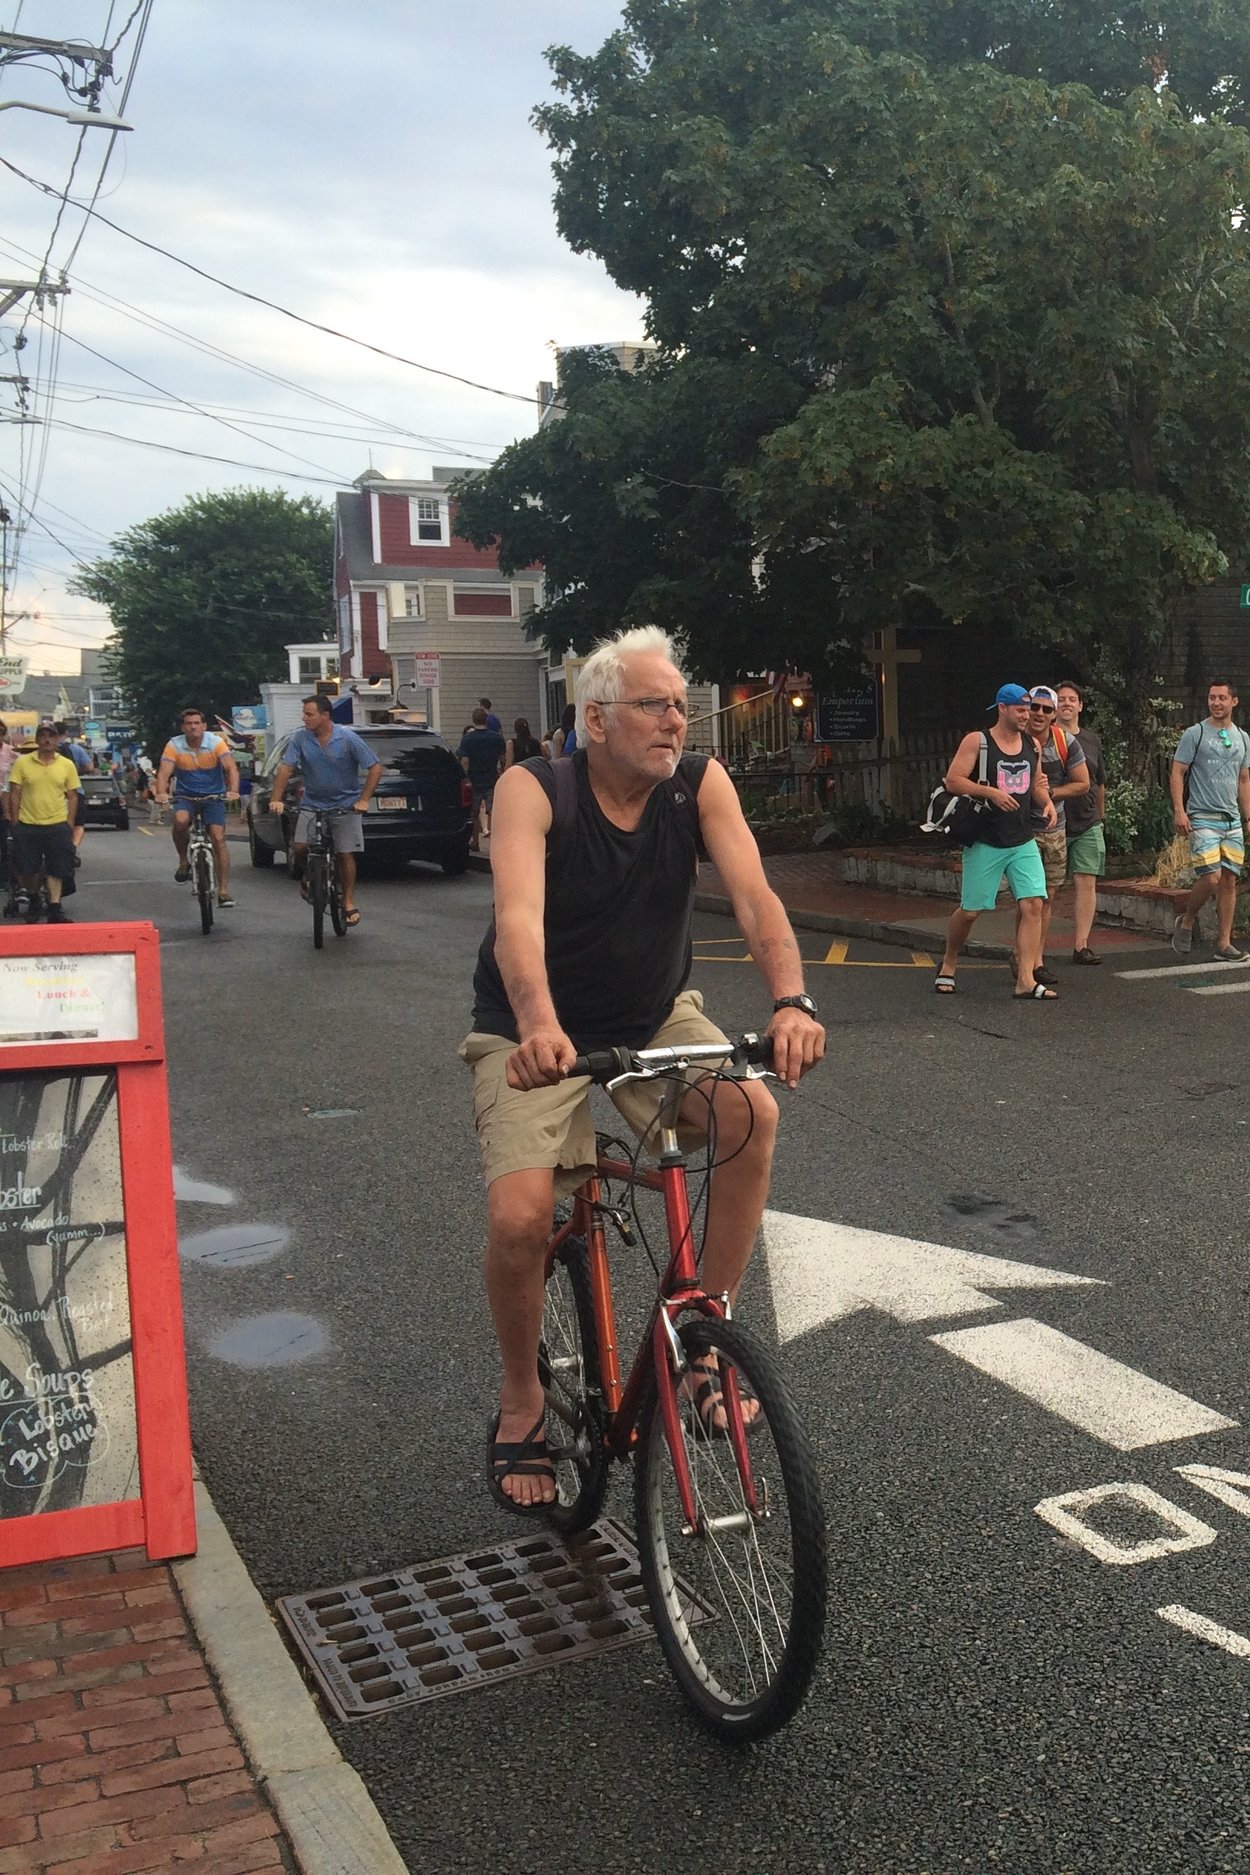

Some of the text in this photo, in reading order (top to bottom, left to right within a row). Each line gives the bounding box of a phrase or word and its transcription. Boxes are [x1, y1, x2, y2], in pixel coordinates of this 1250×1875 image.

[821, 696, 874, 709] Emporium
[4, 960, 78, 973] Now Serving
[36, 987, 90, 999] Lunch &
[2, 1135, 43, 1154] Lobster
[20, 1211, 69, 1232] Avocado
[24, 1362, 94, 1406] Soups
[18, 1402, 92, 1440] Lobster
